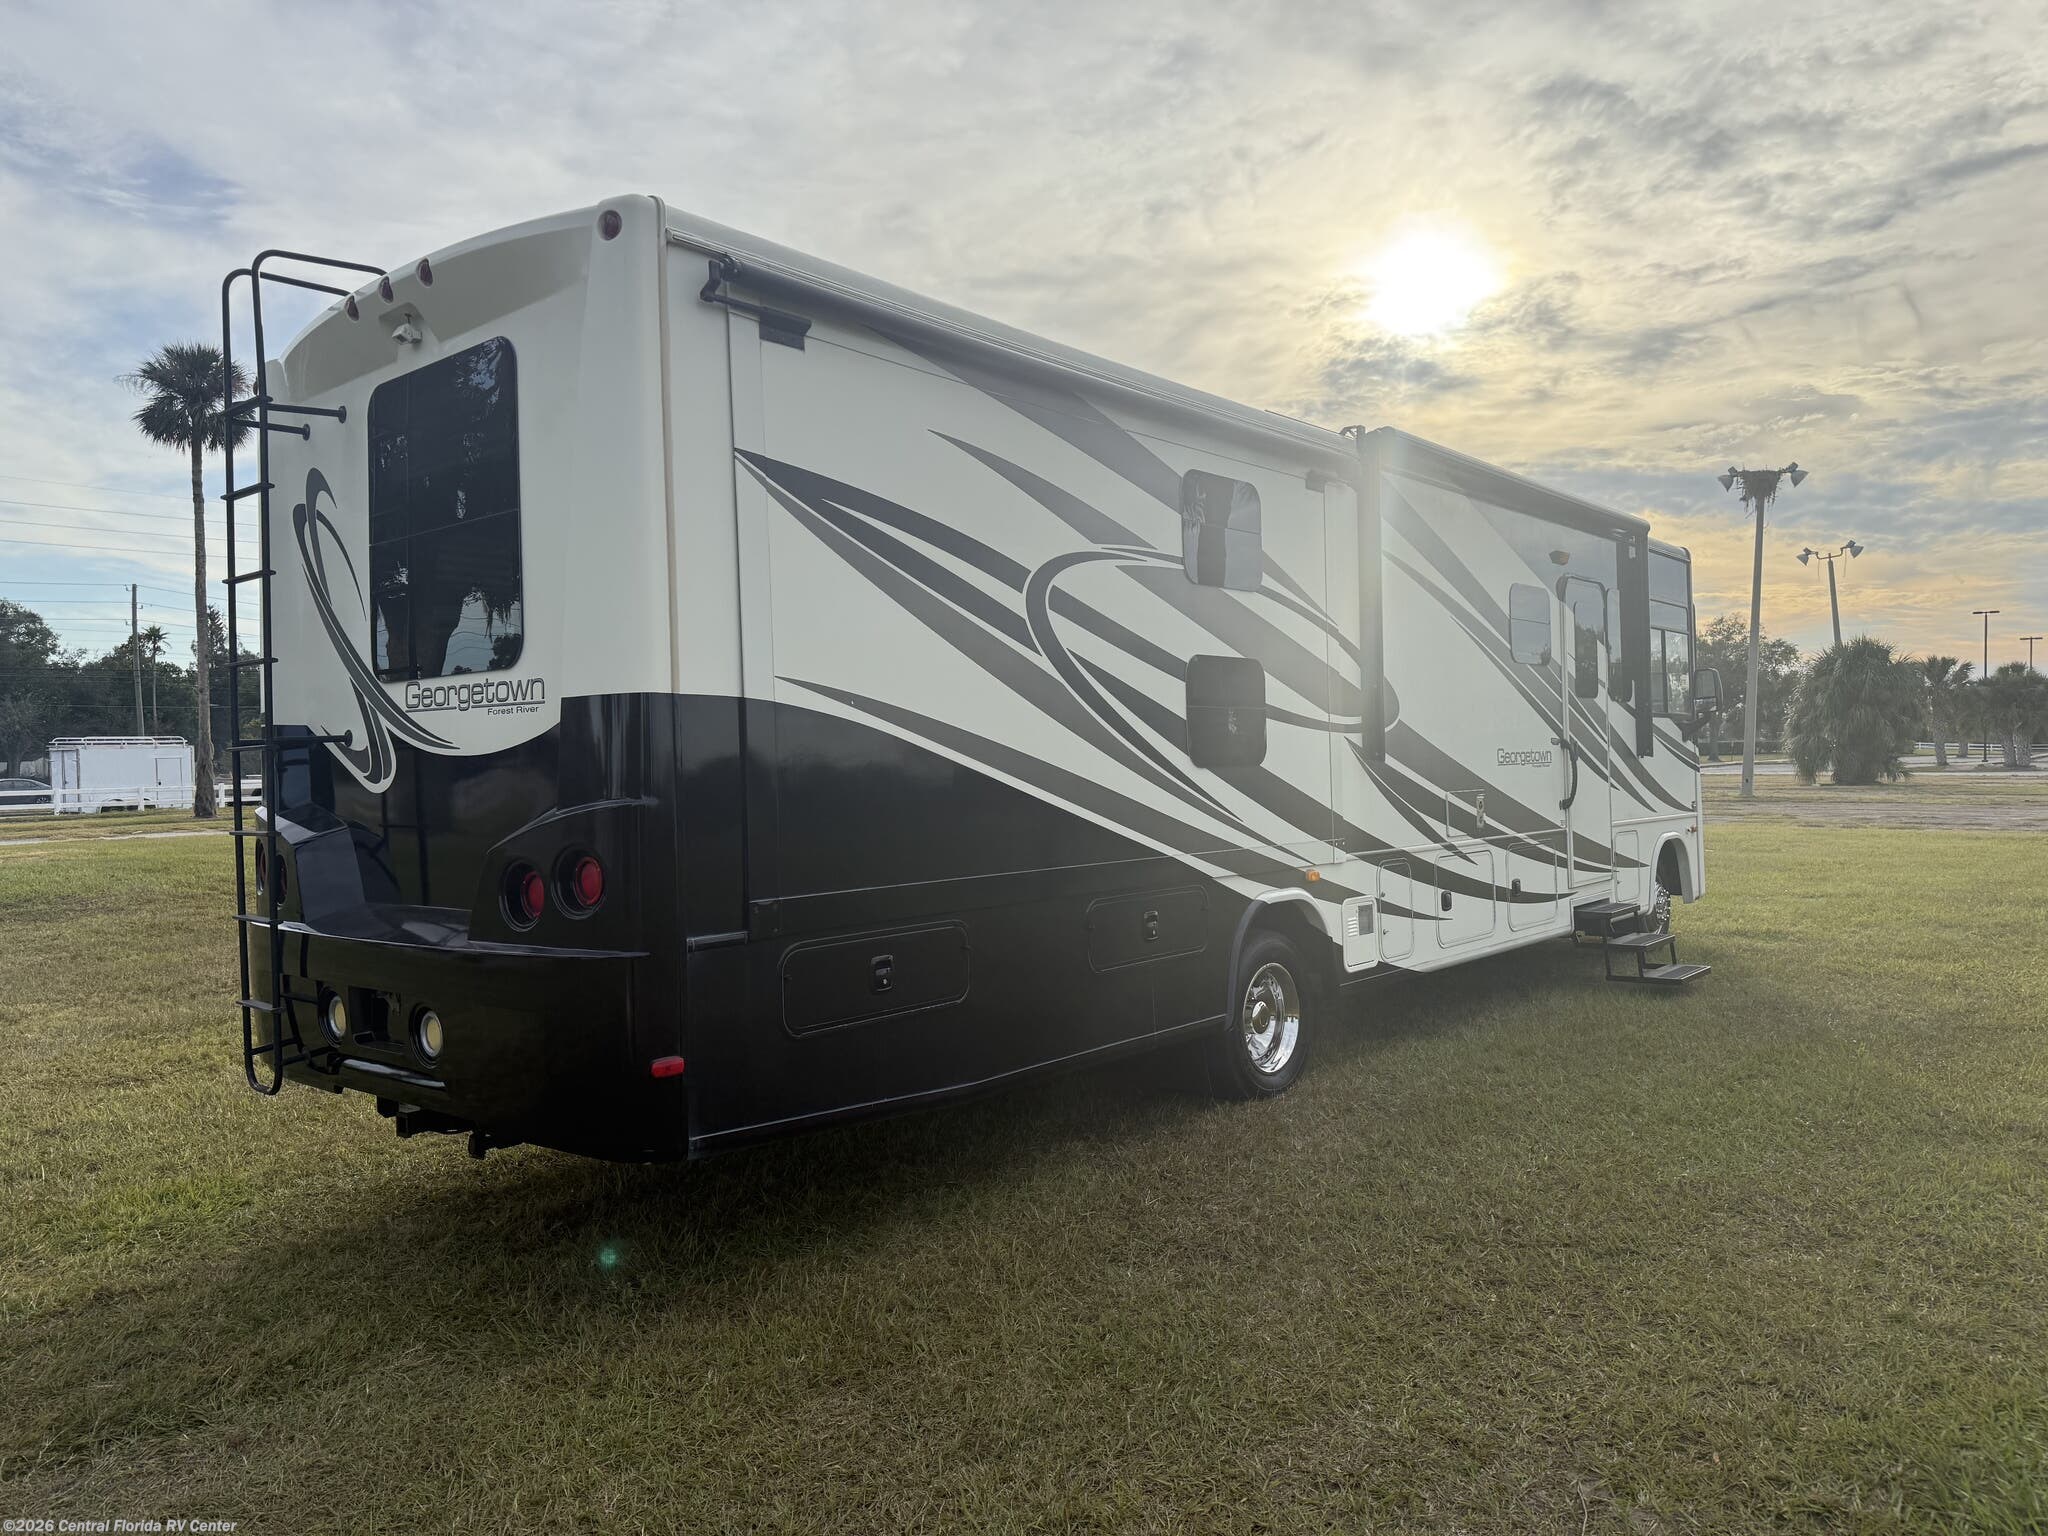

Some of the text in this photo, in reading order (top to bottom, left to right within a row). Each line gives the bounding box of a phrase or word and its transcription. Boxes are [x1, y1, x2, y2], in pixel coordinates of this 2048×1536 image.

[405, 677, 545, 711] Georgetown
[487, 705, 539, 716] Forest River
[1497, 748, 1552, 765] Georgetown
